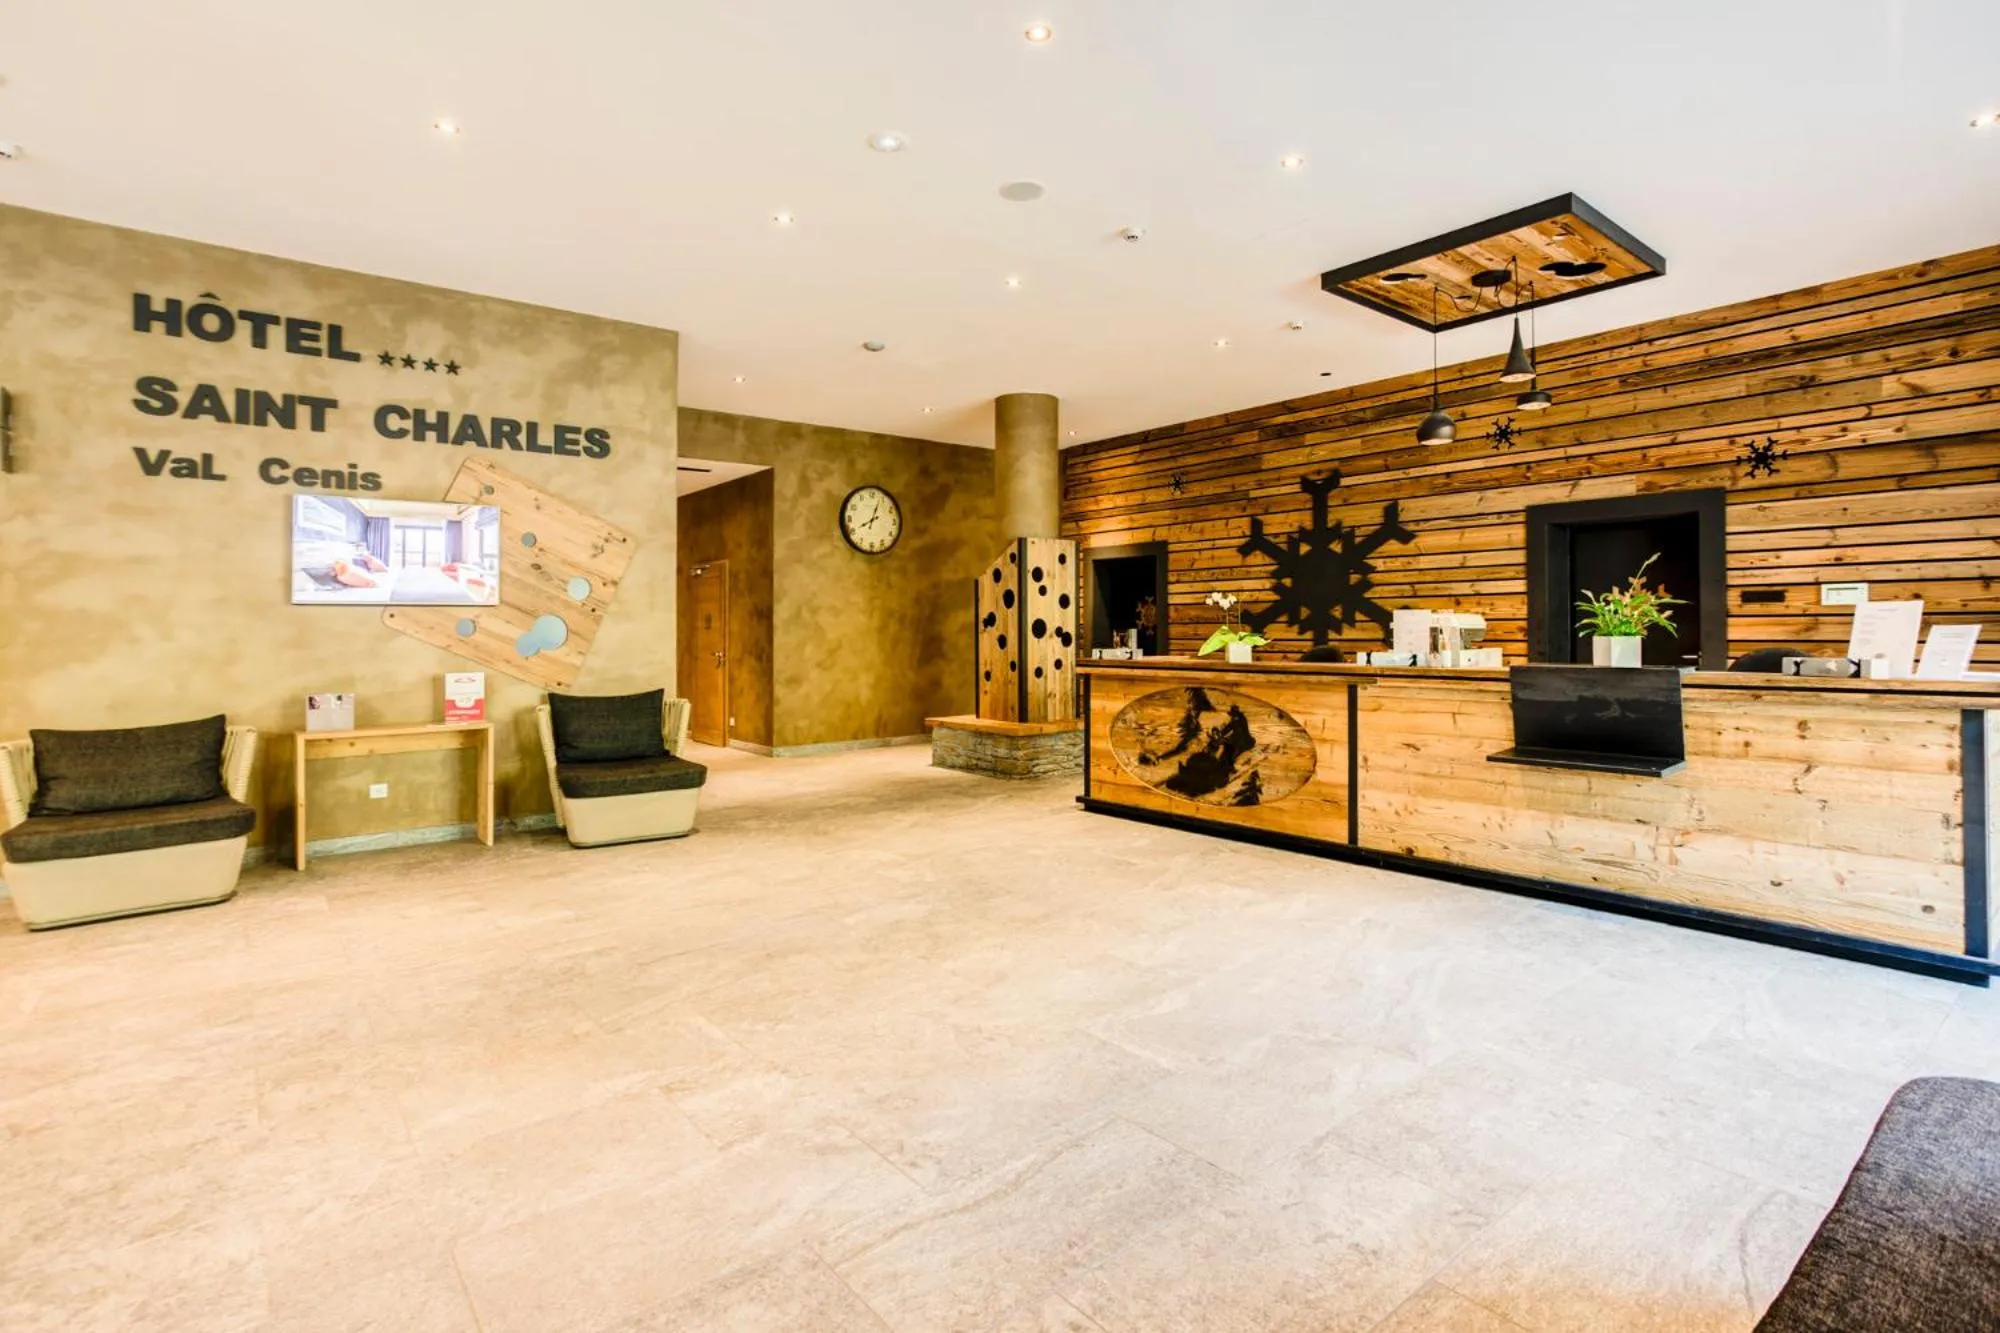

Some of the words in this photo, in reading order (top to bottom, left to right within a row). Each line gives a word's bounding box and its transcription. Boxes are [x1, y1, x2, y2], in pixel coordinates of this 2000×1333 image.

[132, 291, 362, 363] HÔTEL
[132, 376, 338, 433] SAINT
[373, 404, 612, 460] CHARLES
[259, 457, 383, 492] Cenis
